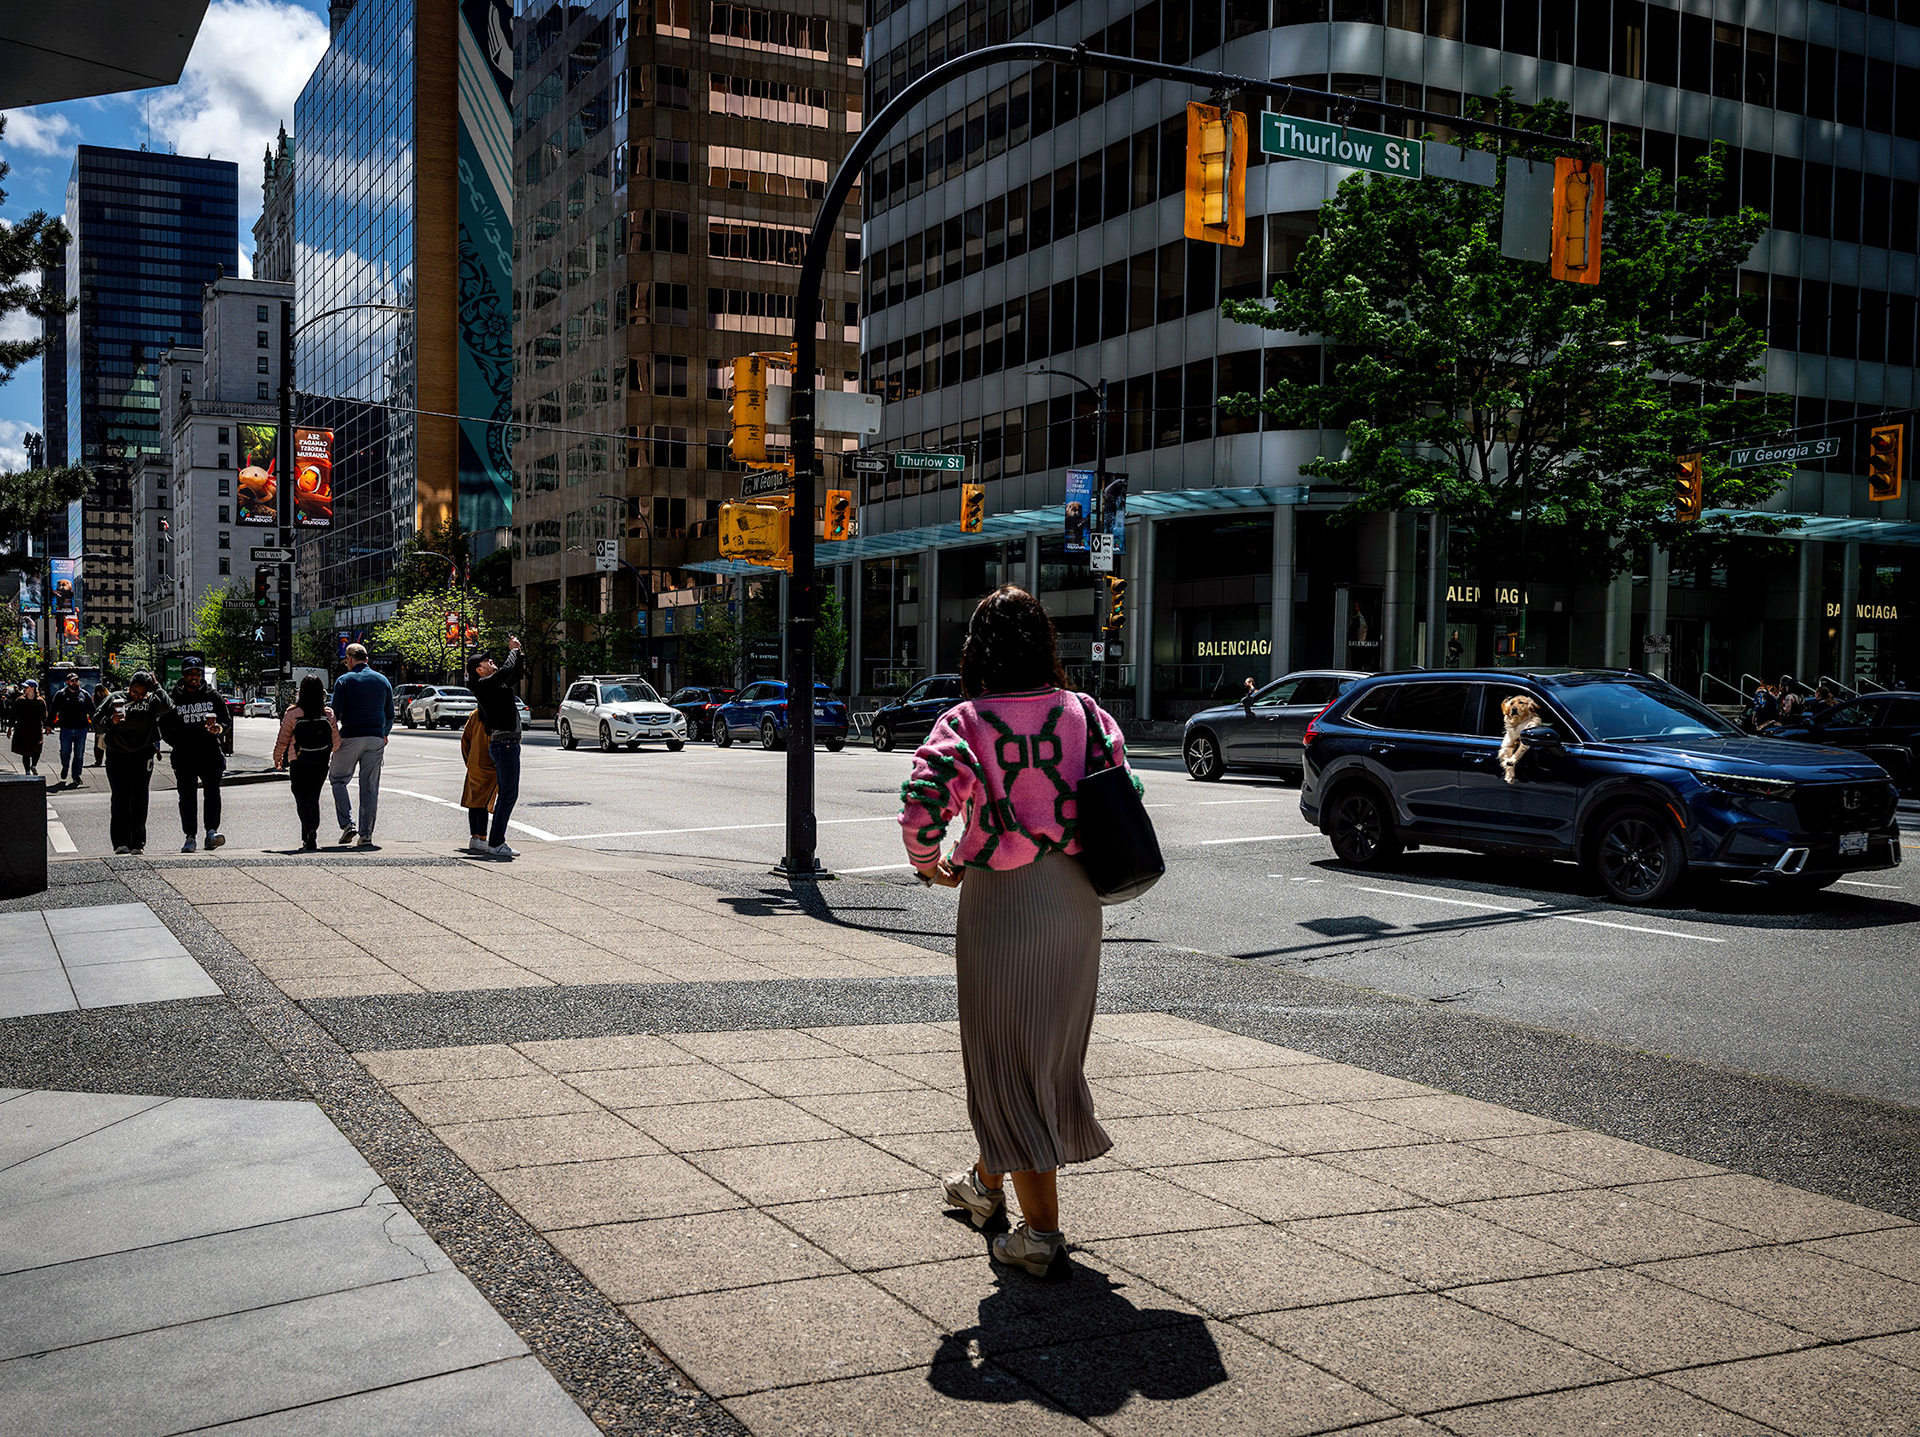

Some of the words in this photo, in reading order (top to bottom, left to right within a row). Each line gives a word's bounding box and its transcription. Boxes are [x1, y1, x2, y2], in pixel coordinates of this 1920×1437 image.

[1274, 122, 1374, 163] Thurlow
[1384, 142, 1411, 172] St
[1737, 451, 1750, 464] W
[1754, 445, 1809, 460] Georgia
[1815, 441, 1832, 454] St
[901, 455, 943, 467] Thurlow
[947, 457, 960, 468] St
[753, 477, 760, 490] W
[760, 473, 783, 490] Georgia
[224, 600, 255, 608] Thurlow
[1826, 602, 1898, 620] BANCIAGA
[176, 701, 214, 715] MAGIC
[183, 713, 207, 723] CITY
